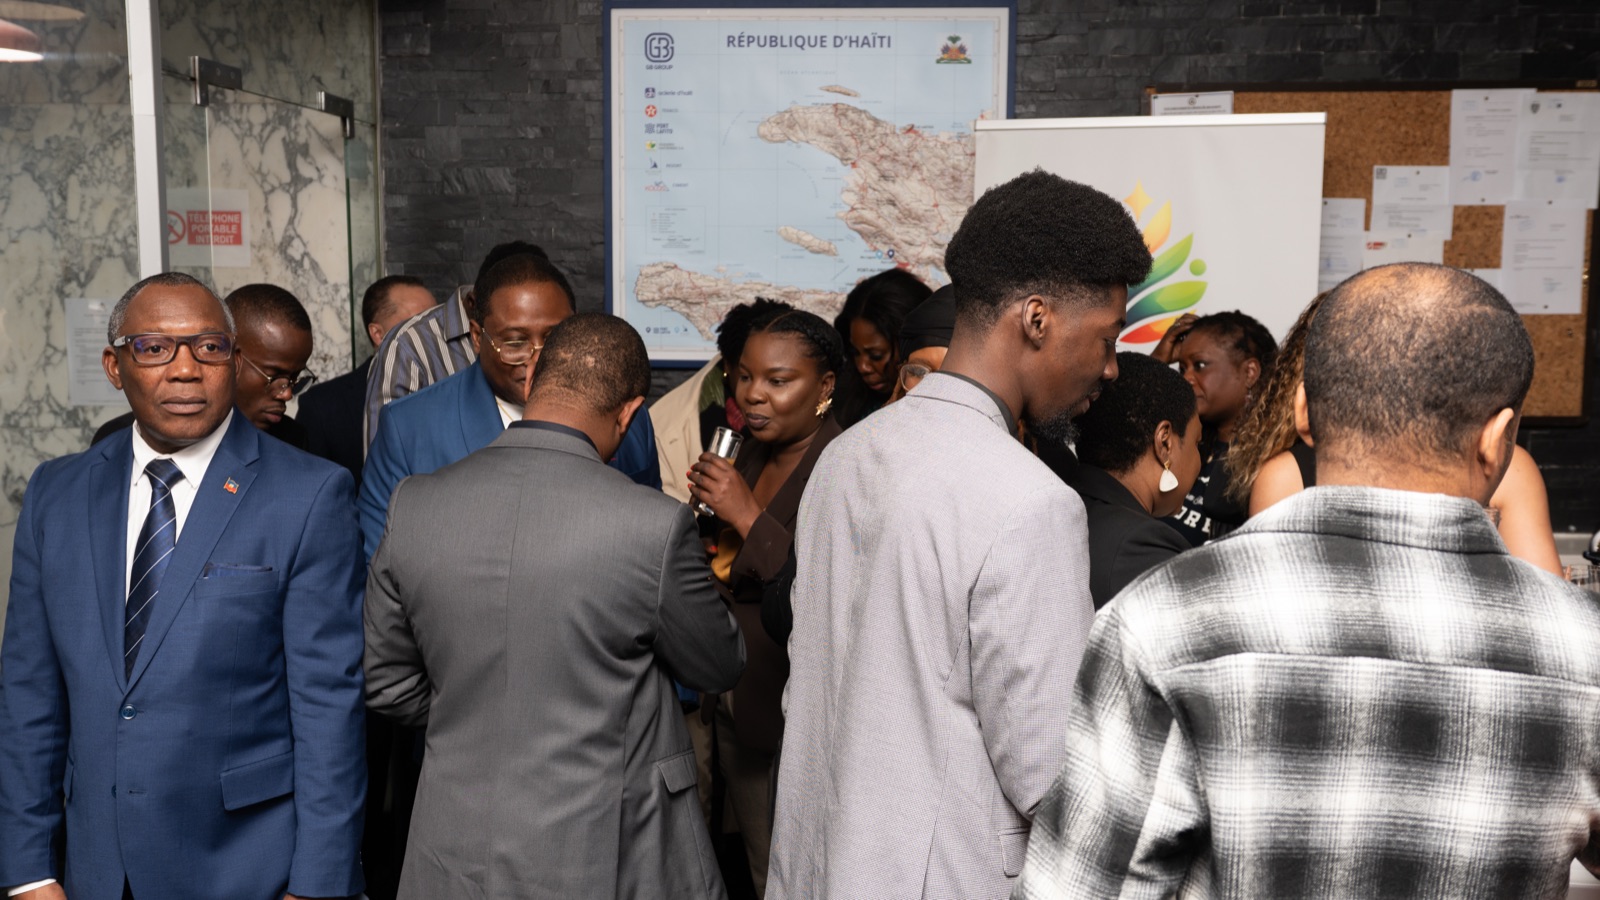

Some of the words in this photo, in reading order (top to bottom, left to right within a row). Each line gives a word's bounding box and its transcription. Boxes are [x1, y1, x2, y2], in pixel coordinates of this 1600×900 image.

[726, 31, 828, 50] RÉPUBLIQUE
[191, 224, 237, 233] PORABLE
[195, 235, 234, 244] INTRDIT
